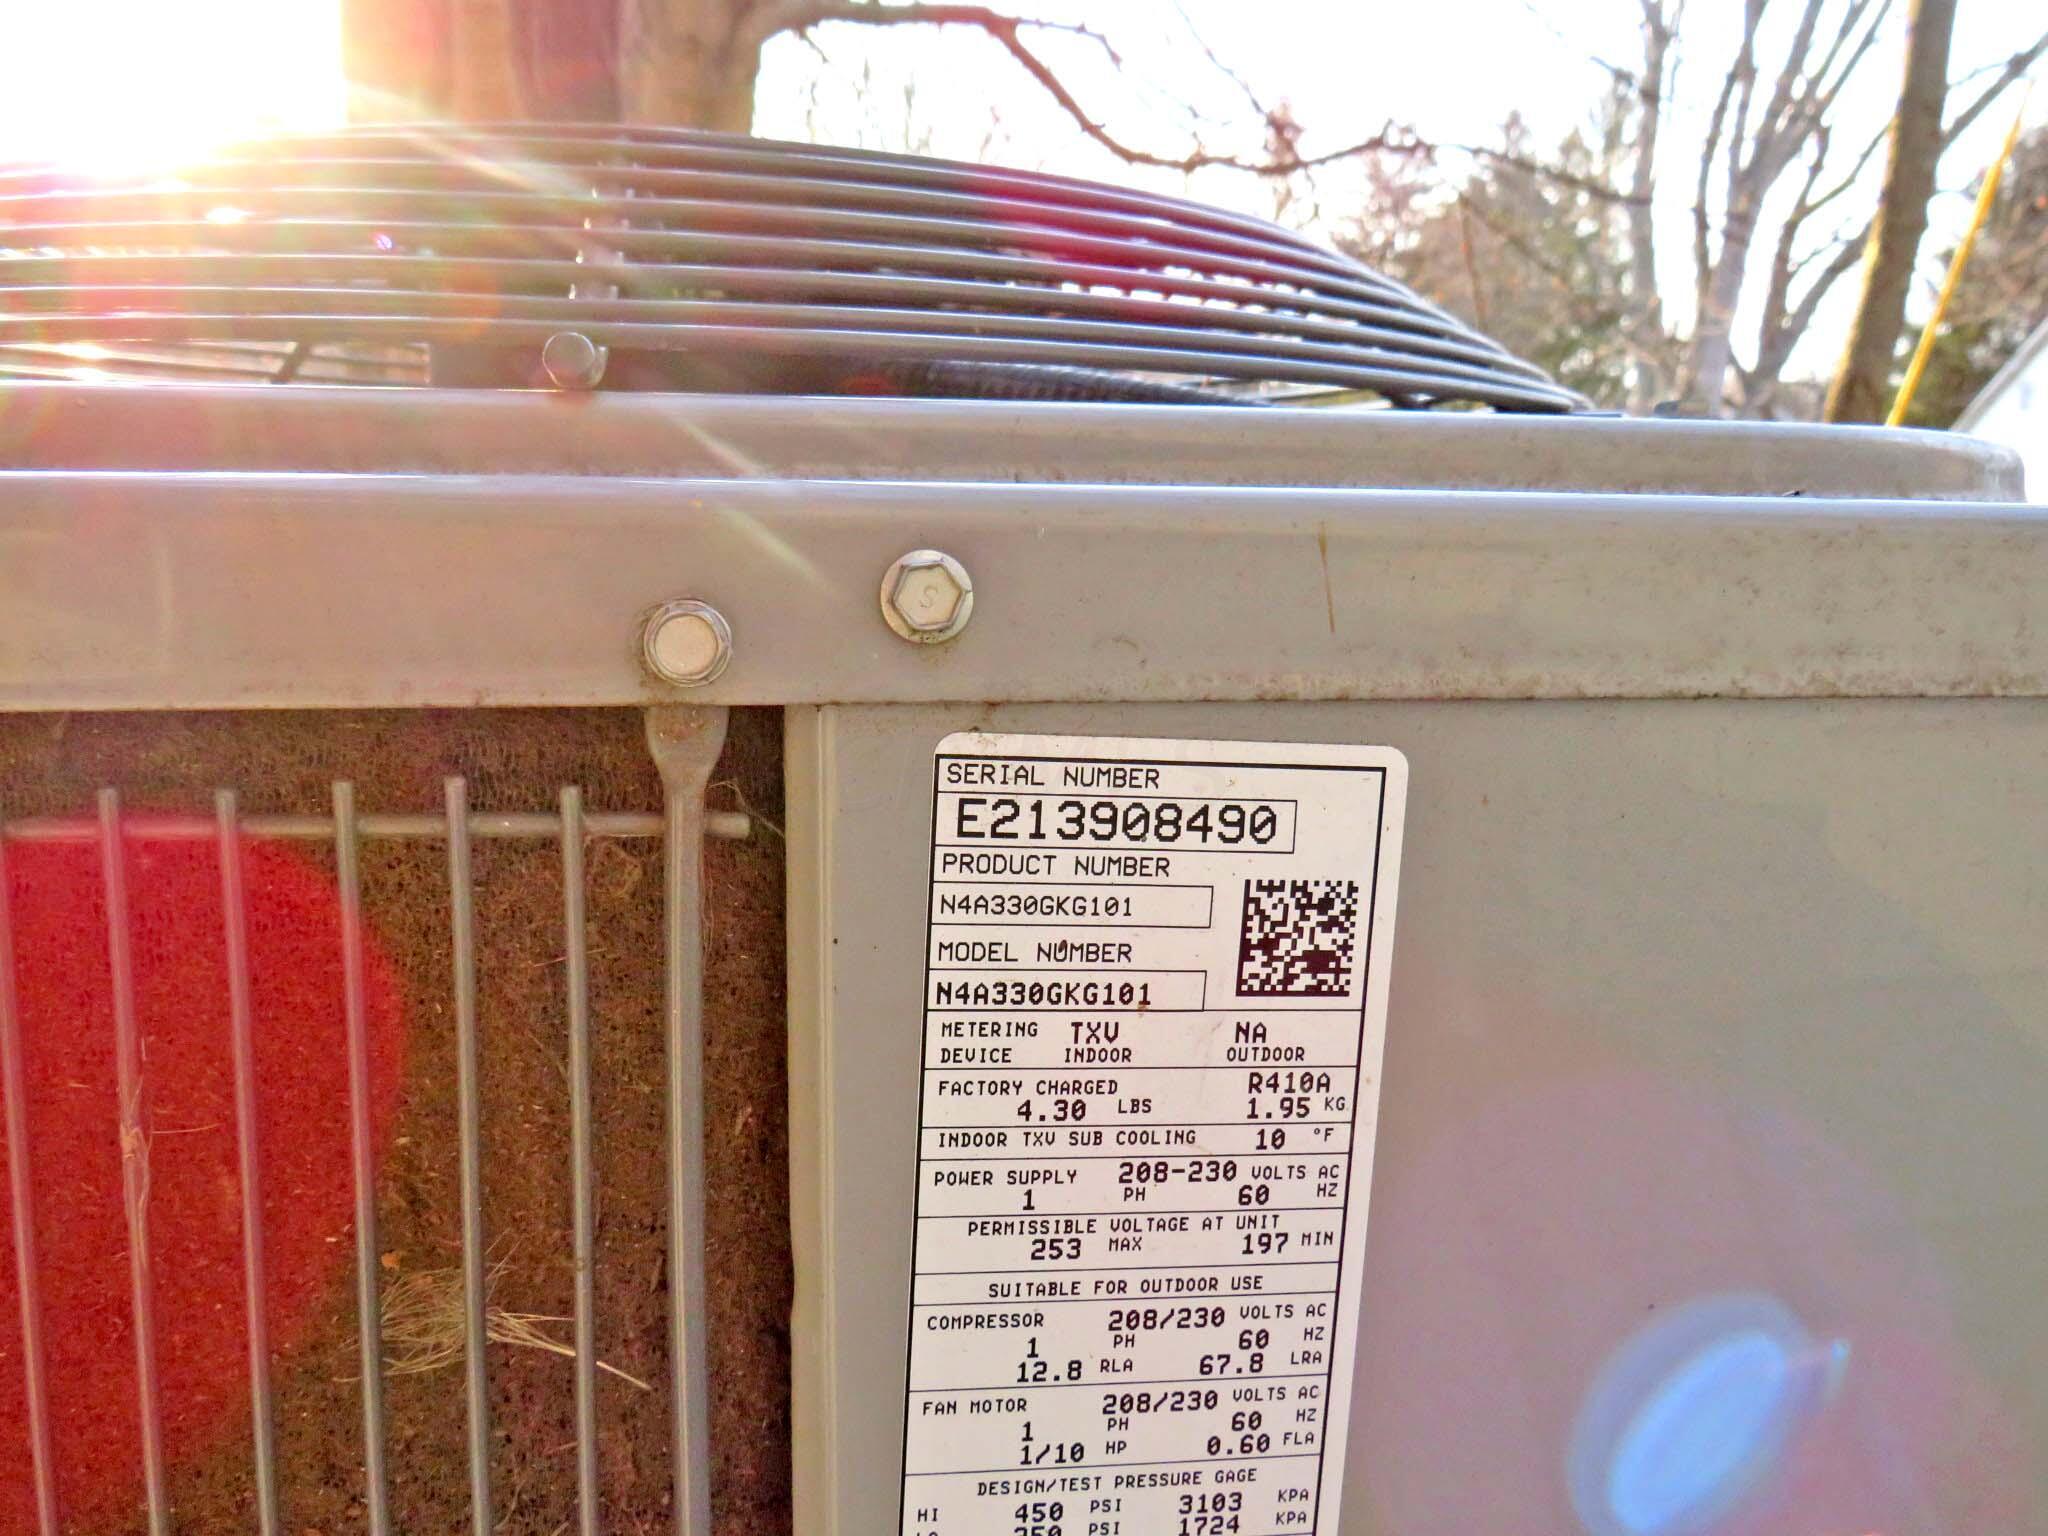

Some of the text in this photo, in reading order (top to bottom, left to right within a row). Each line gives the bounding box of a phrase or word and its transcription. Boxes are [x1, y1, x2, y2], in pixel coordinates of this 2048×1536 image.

[947, 763, 1159, 789] SERIAL NUMBER
[957, 798, 1276, 844] E213908490
[943, 853, 1170, 877] PRODUCT NUMBER
[941, 894, 1131, 916] N4A330GKG101
[939, 940, 1132, 963] MODEL NUMBER
[937, 982, 1151, 1006] N4A330GKG101
[942, 1022, 1267, 1044] METERING TXV NA
[941, 1047, 1304, 1063] DEVICE INDOOR OUTDOOR
[939, 1072, 1330, 1095] FACTORY CHARGED R410A
[1018, 1097, 1345, 1121] 4.30 LBS 1.95 KG
[939, 1132, 1007, 1147] INDOOR
[1023, 1132, 1055, 1146] TXV
[1069, 1131, 1102, 1146] SUB
[1116, 1130, 1195, 1145] COOLING
[1256, 1128, 1285, 1150] 10
[935, 1160, 1339, 1186] POWER SUPPLY 208-230 VOLTS AC
[1023, 1183, 1338, 1210] 1 PH 60 HZ
[968, 1215, 1279, 1236] PERMISSIBLE VOLTAGE AT UNIT
[1031, 1232, 1333, 1260] 253 MAX 197 MIN
[989, 1276, 1263, 1298] SUITABLE FOR OUTDOOR USE
[928, 1303, 1326, 1331] COMPRESSOR 208/230 VOLTS AC
[1027, 1327, 1324, 1358] 1 PH 60 HZ
[1017, 1351, 1322, 1382] 12.8 RLA 67.8 LRA
[923, 1385, 1318, 1415] FAN MOTOR 208/230 VOLTS AC
[1022, 1408, 1316, 1442] 1 PH 60 HZ
[1020, 1432, 1314, 1465] 1/10 HP 0.60 FLA
[978, 1468, 1256, 1496] DESIGN/TEST PRESSURE GAGE
[918, 1489, 1308, 1523] HI 450 PSI 3103 KPA
[1089, 1522, 1119, 1536] PSI
[1179, 1514, 1239, 1536] 1724
[1276, 1511, 1306, 1525] KPA
